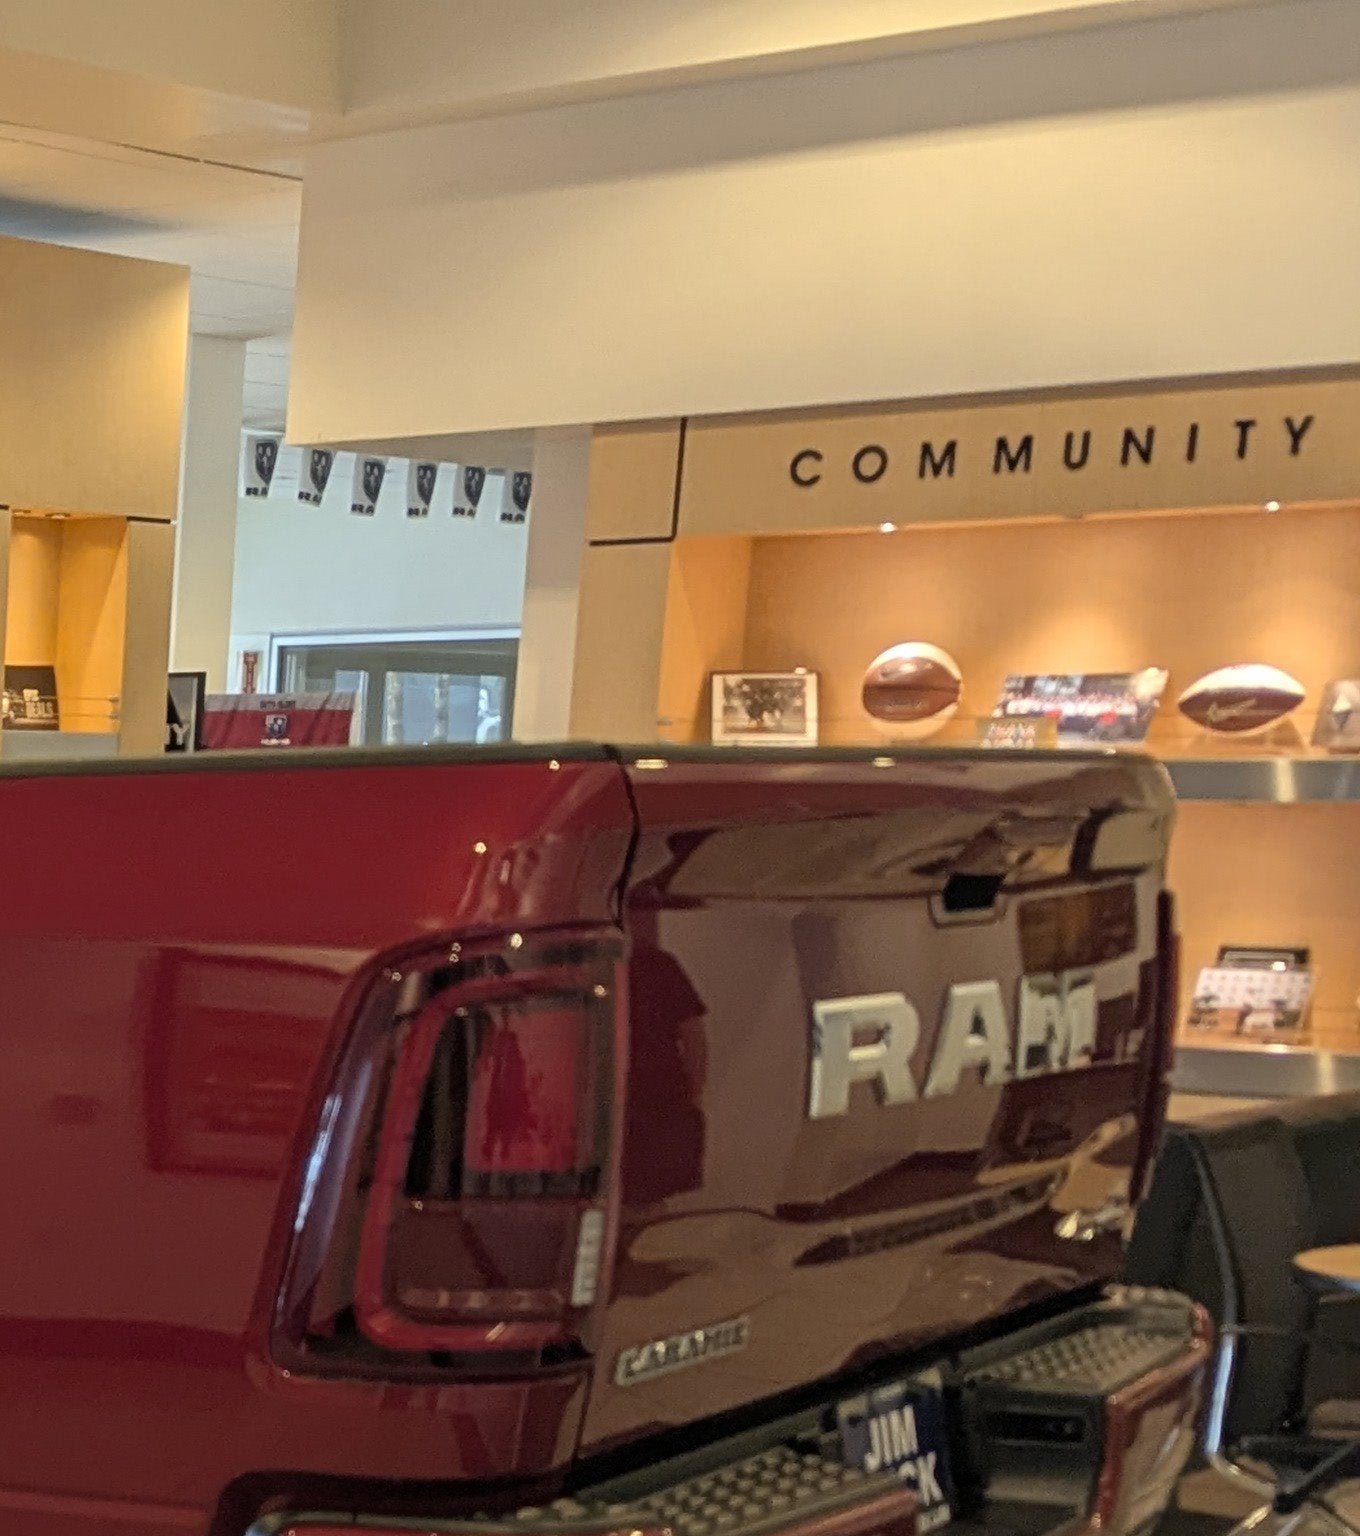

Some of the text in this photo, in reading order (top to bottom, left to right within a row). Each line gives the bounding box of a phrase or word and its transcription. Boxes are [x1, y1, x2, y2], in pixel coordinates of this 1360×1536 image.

[788, 415, 1314, 487] COMMUNITY
[809, 966, 1099, 1120] RAM
[864, 1404, 919, 1473] JIM
